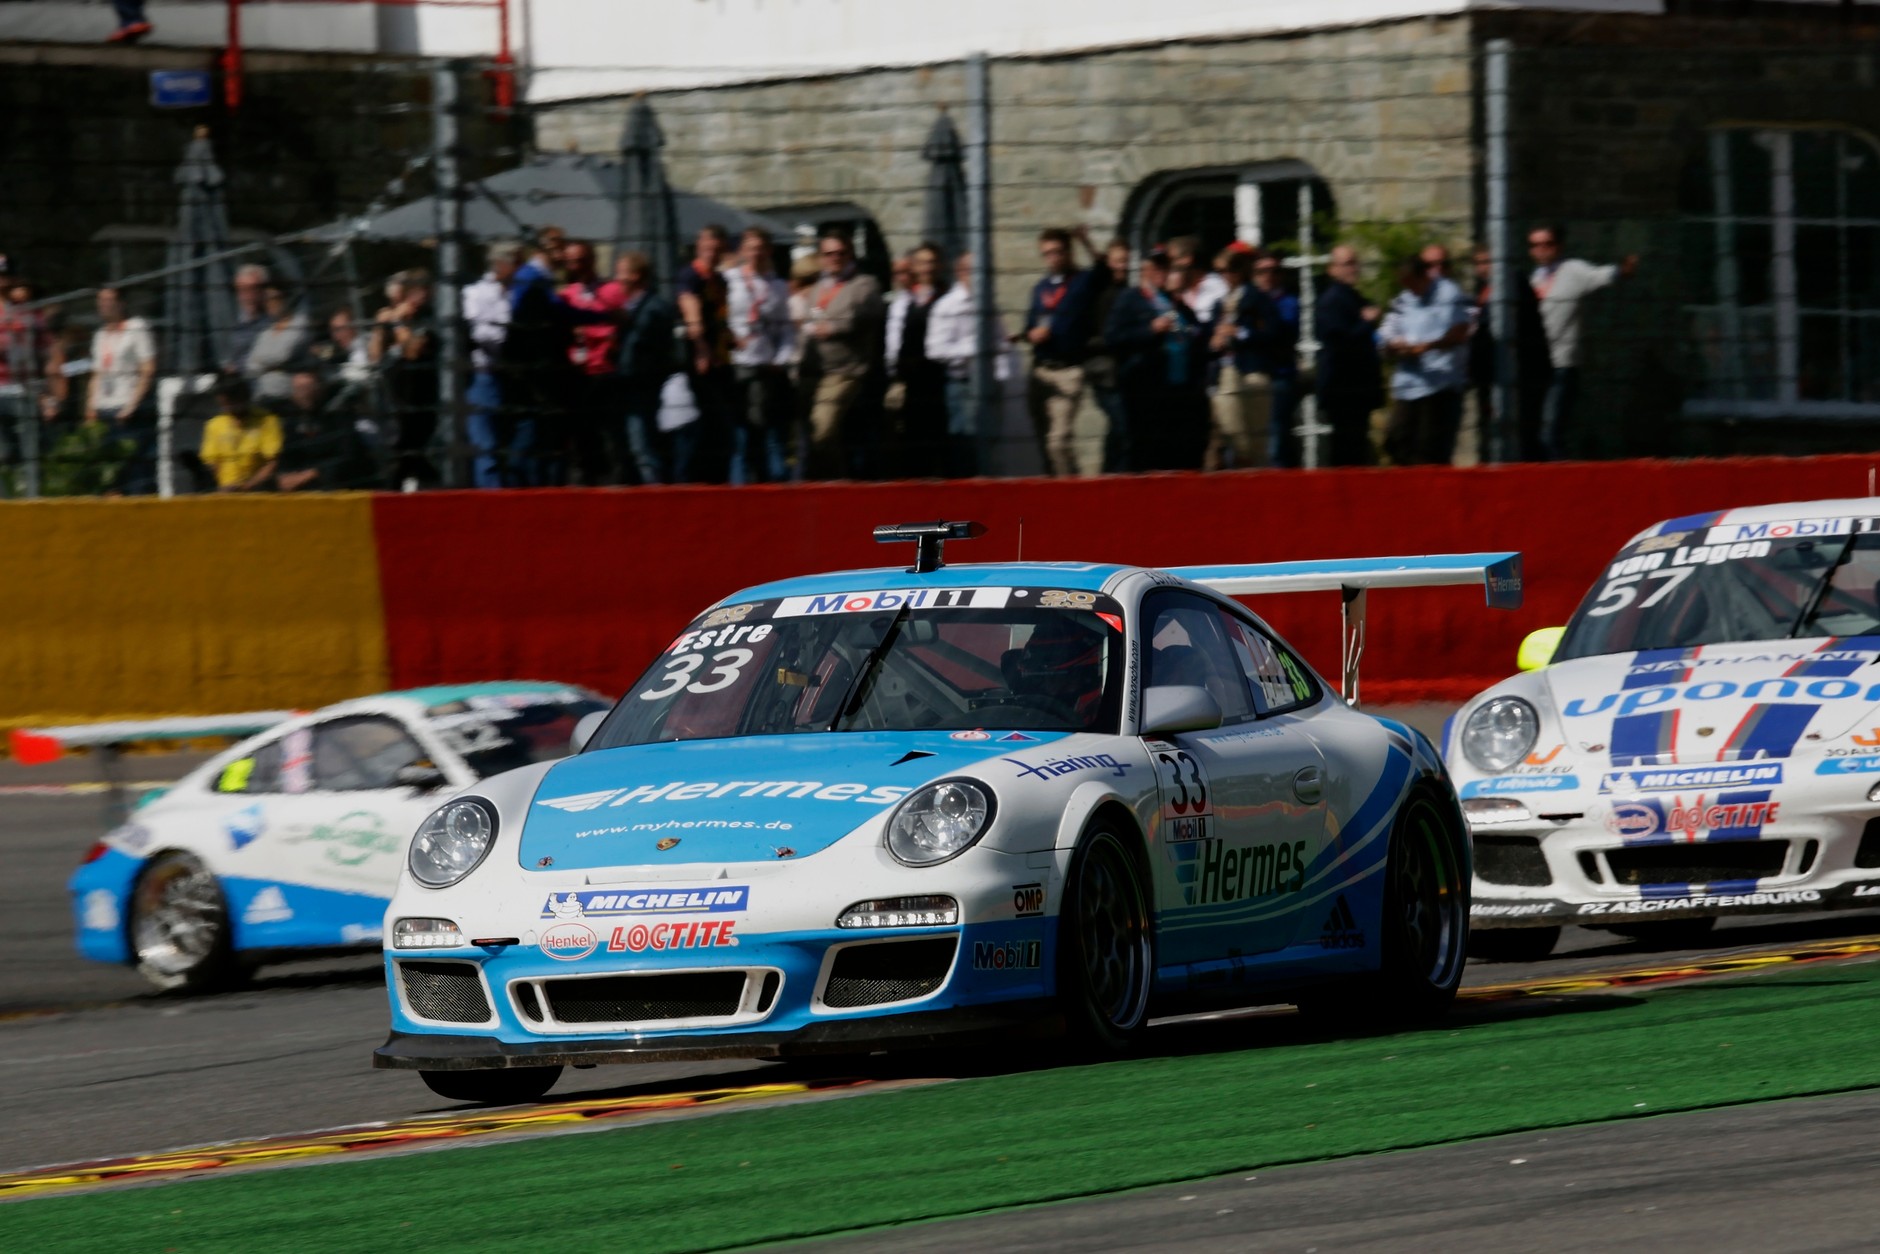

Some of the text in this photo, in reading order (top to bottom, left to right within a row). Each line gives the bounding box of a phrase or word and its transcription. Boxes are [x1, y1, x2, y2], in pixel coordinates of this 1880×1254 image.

[1736, 519, 1874, 540] Mobil 1
[1606, 551, 1667, 580] van
[1671, 540, 1770, 565] Lagen
[806, 590, 964, 614] Mobil 1
[1587, 566, 1697, 617] 57
[671, 623, 773, 656] Estre
[639, 648, 754, 700] 33
[1629, 652, 1867, 675] NATHAN.NL
[1158, 752, 1206, 814] 33
[1640, 766, 1780, 787] MICHELIN
[609, 781, 914, 807] Hermes
[576, 819, 793, 839] www.myhermes.de
[1173, 818, 1197, 840] Mobil
[1666, 801, 1782, 832] LOCTITE
[1200, 838, 1306, 904] Hermes
[586, 890, 743, 910] MICHELIN
[1014, 888, 1043, 912] OMP
[1577, 889, 1821, 914] PZ ASCHAFFENBURG
[545, 933, 594, 949] Henkel
[606, 920, 736, 953] LOCTITE
[973, 939, 1026, 970] Mobil
